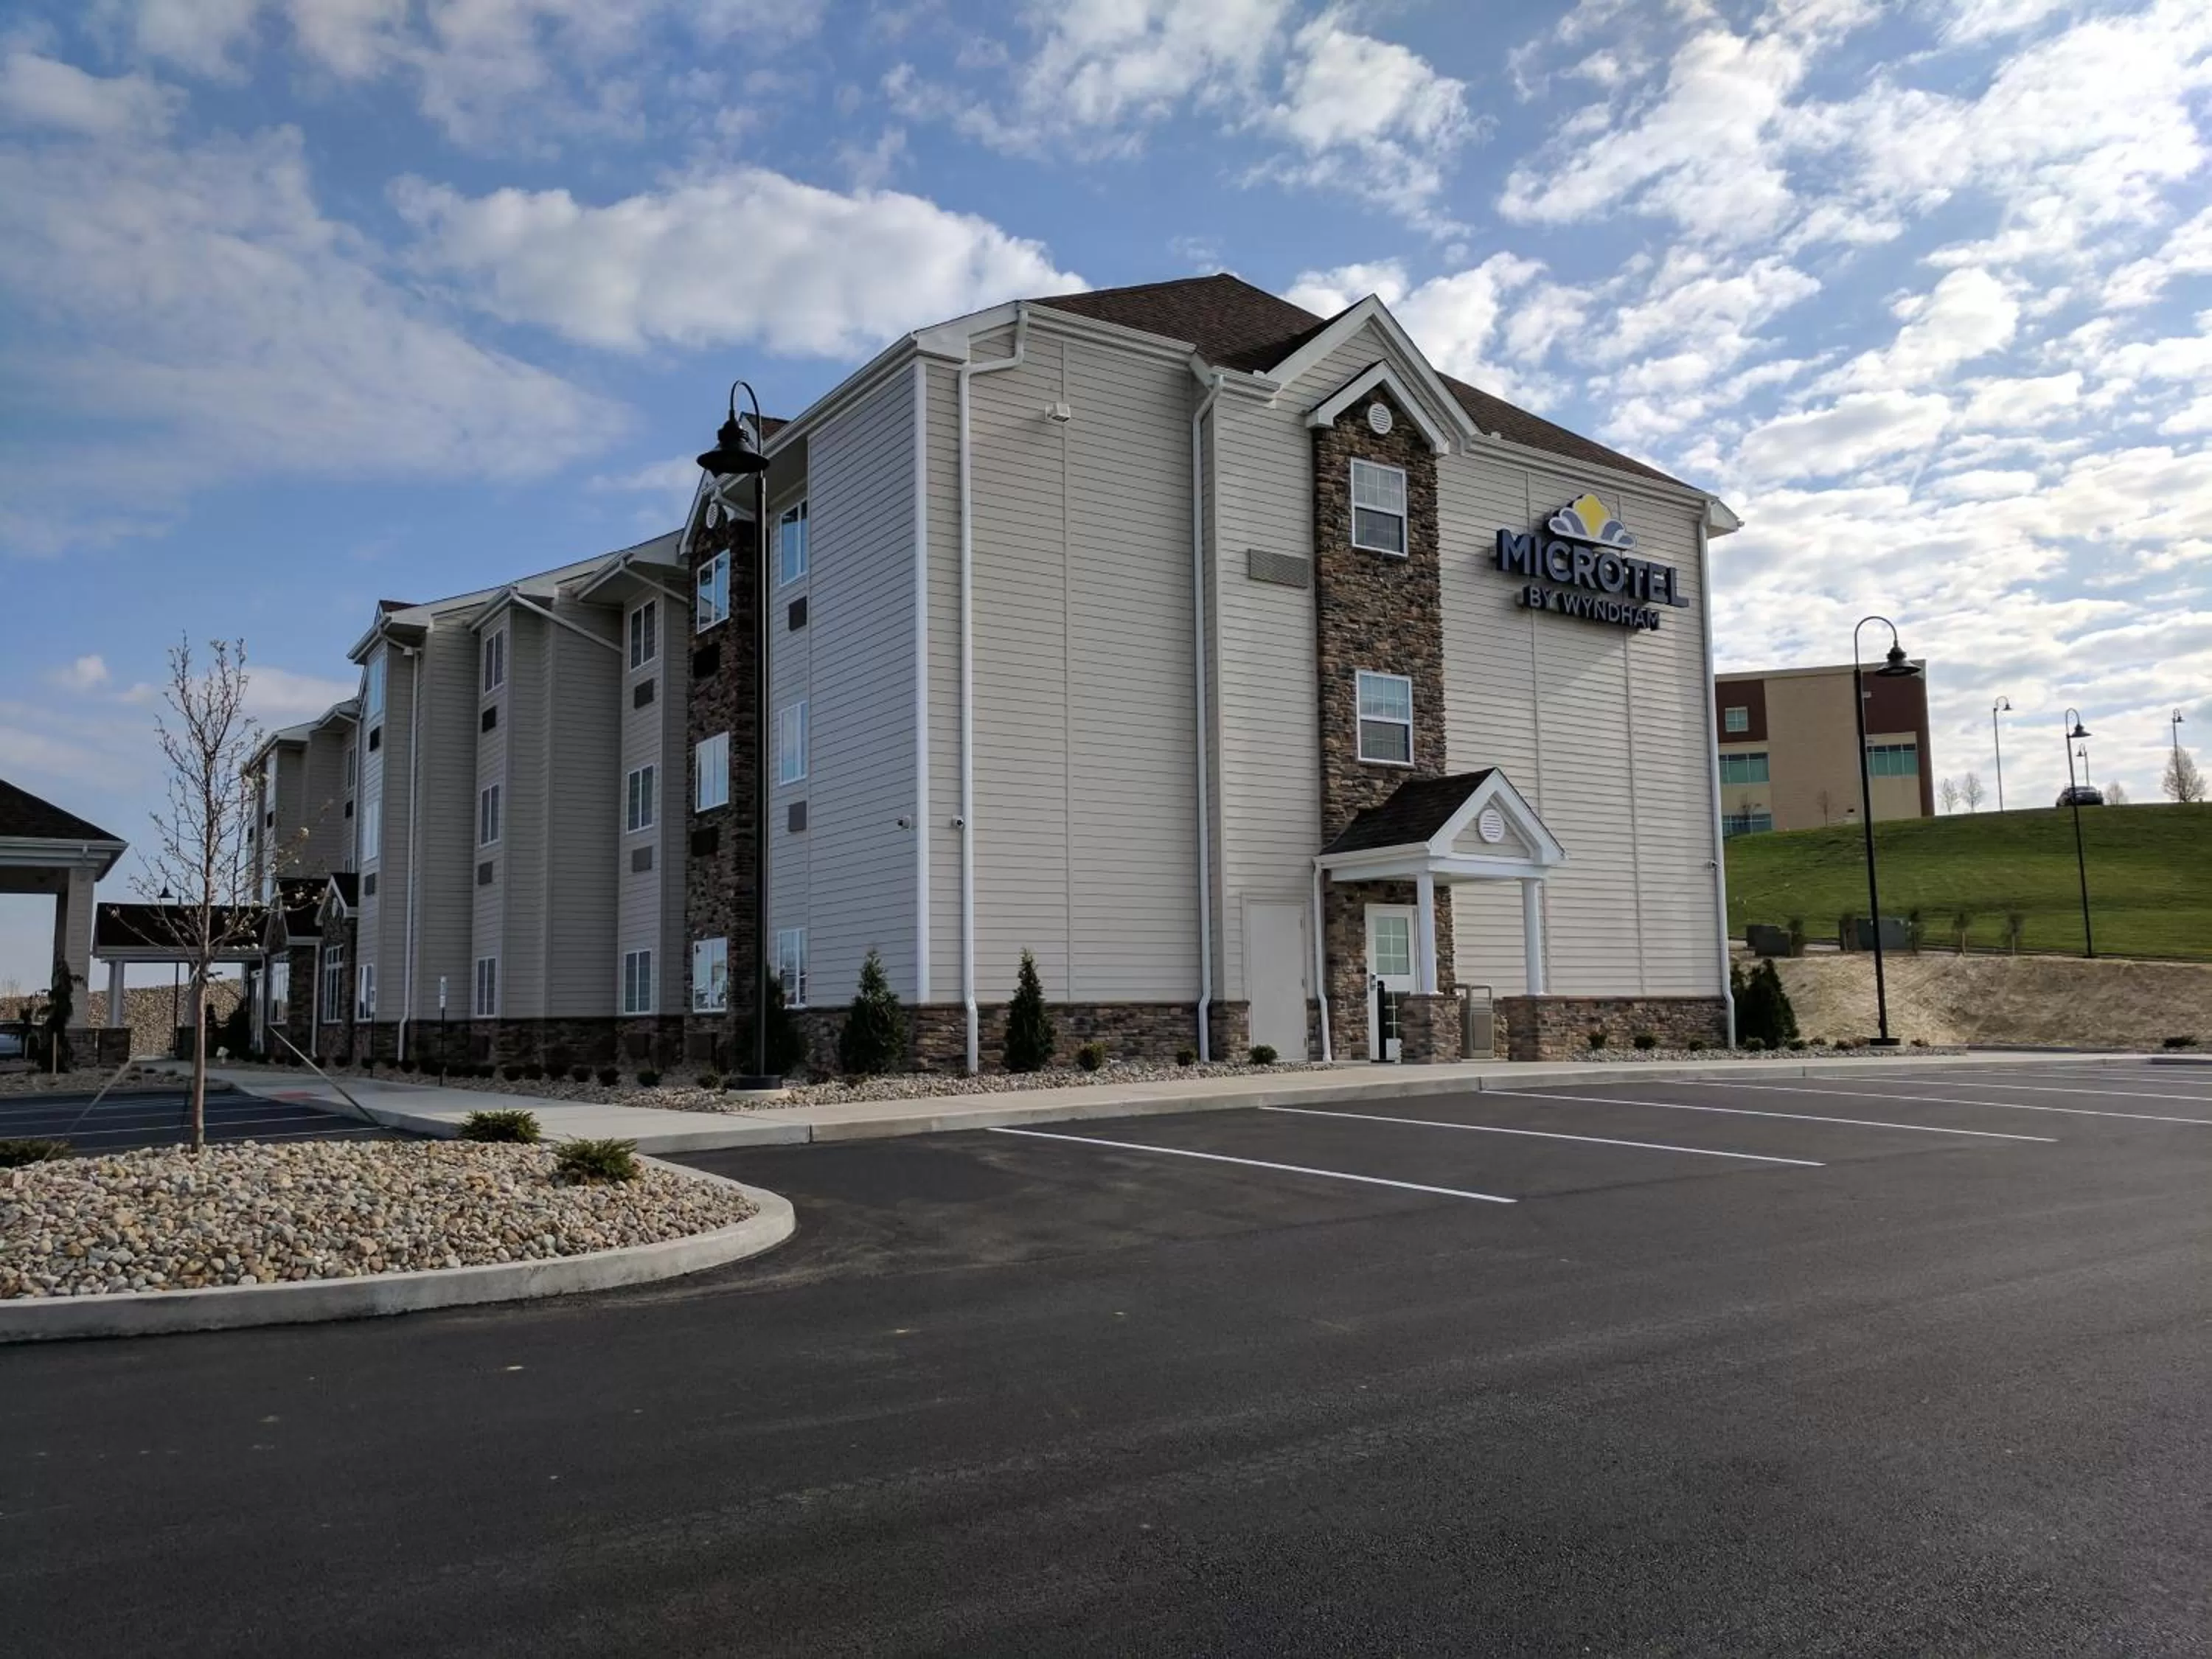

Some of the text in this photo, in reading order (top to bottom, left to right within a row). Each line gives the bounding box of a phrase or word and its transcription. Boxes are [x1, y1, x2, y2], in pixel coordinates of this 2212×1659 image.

[1498, 529, 1689, 608] MICROTEL
[1526, 587, 1659, 629] BY WYNDHAM
